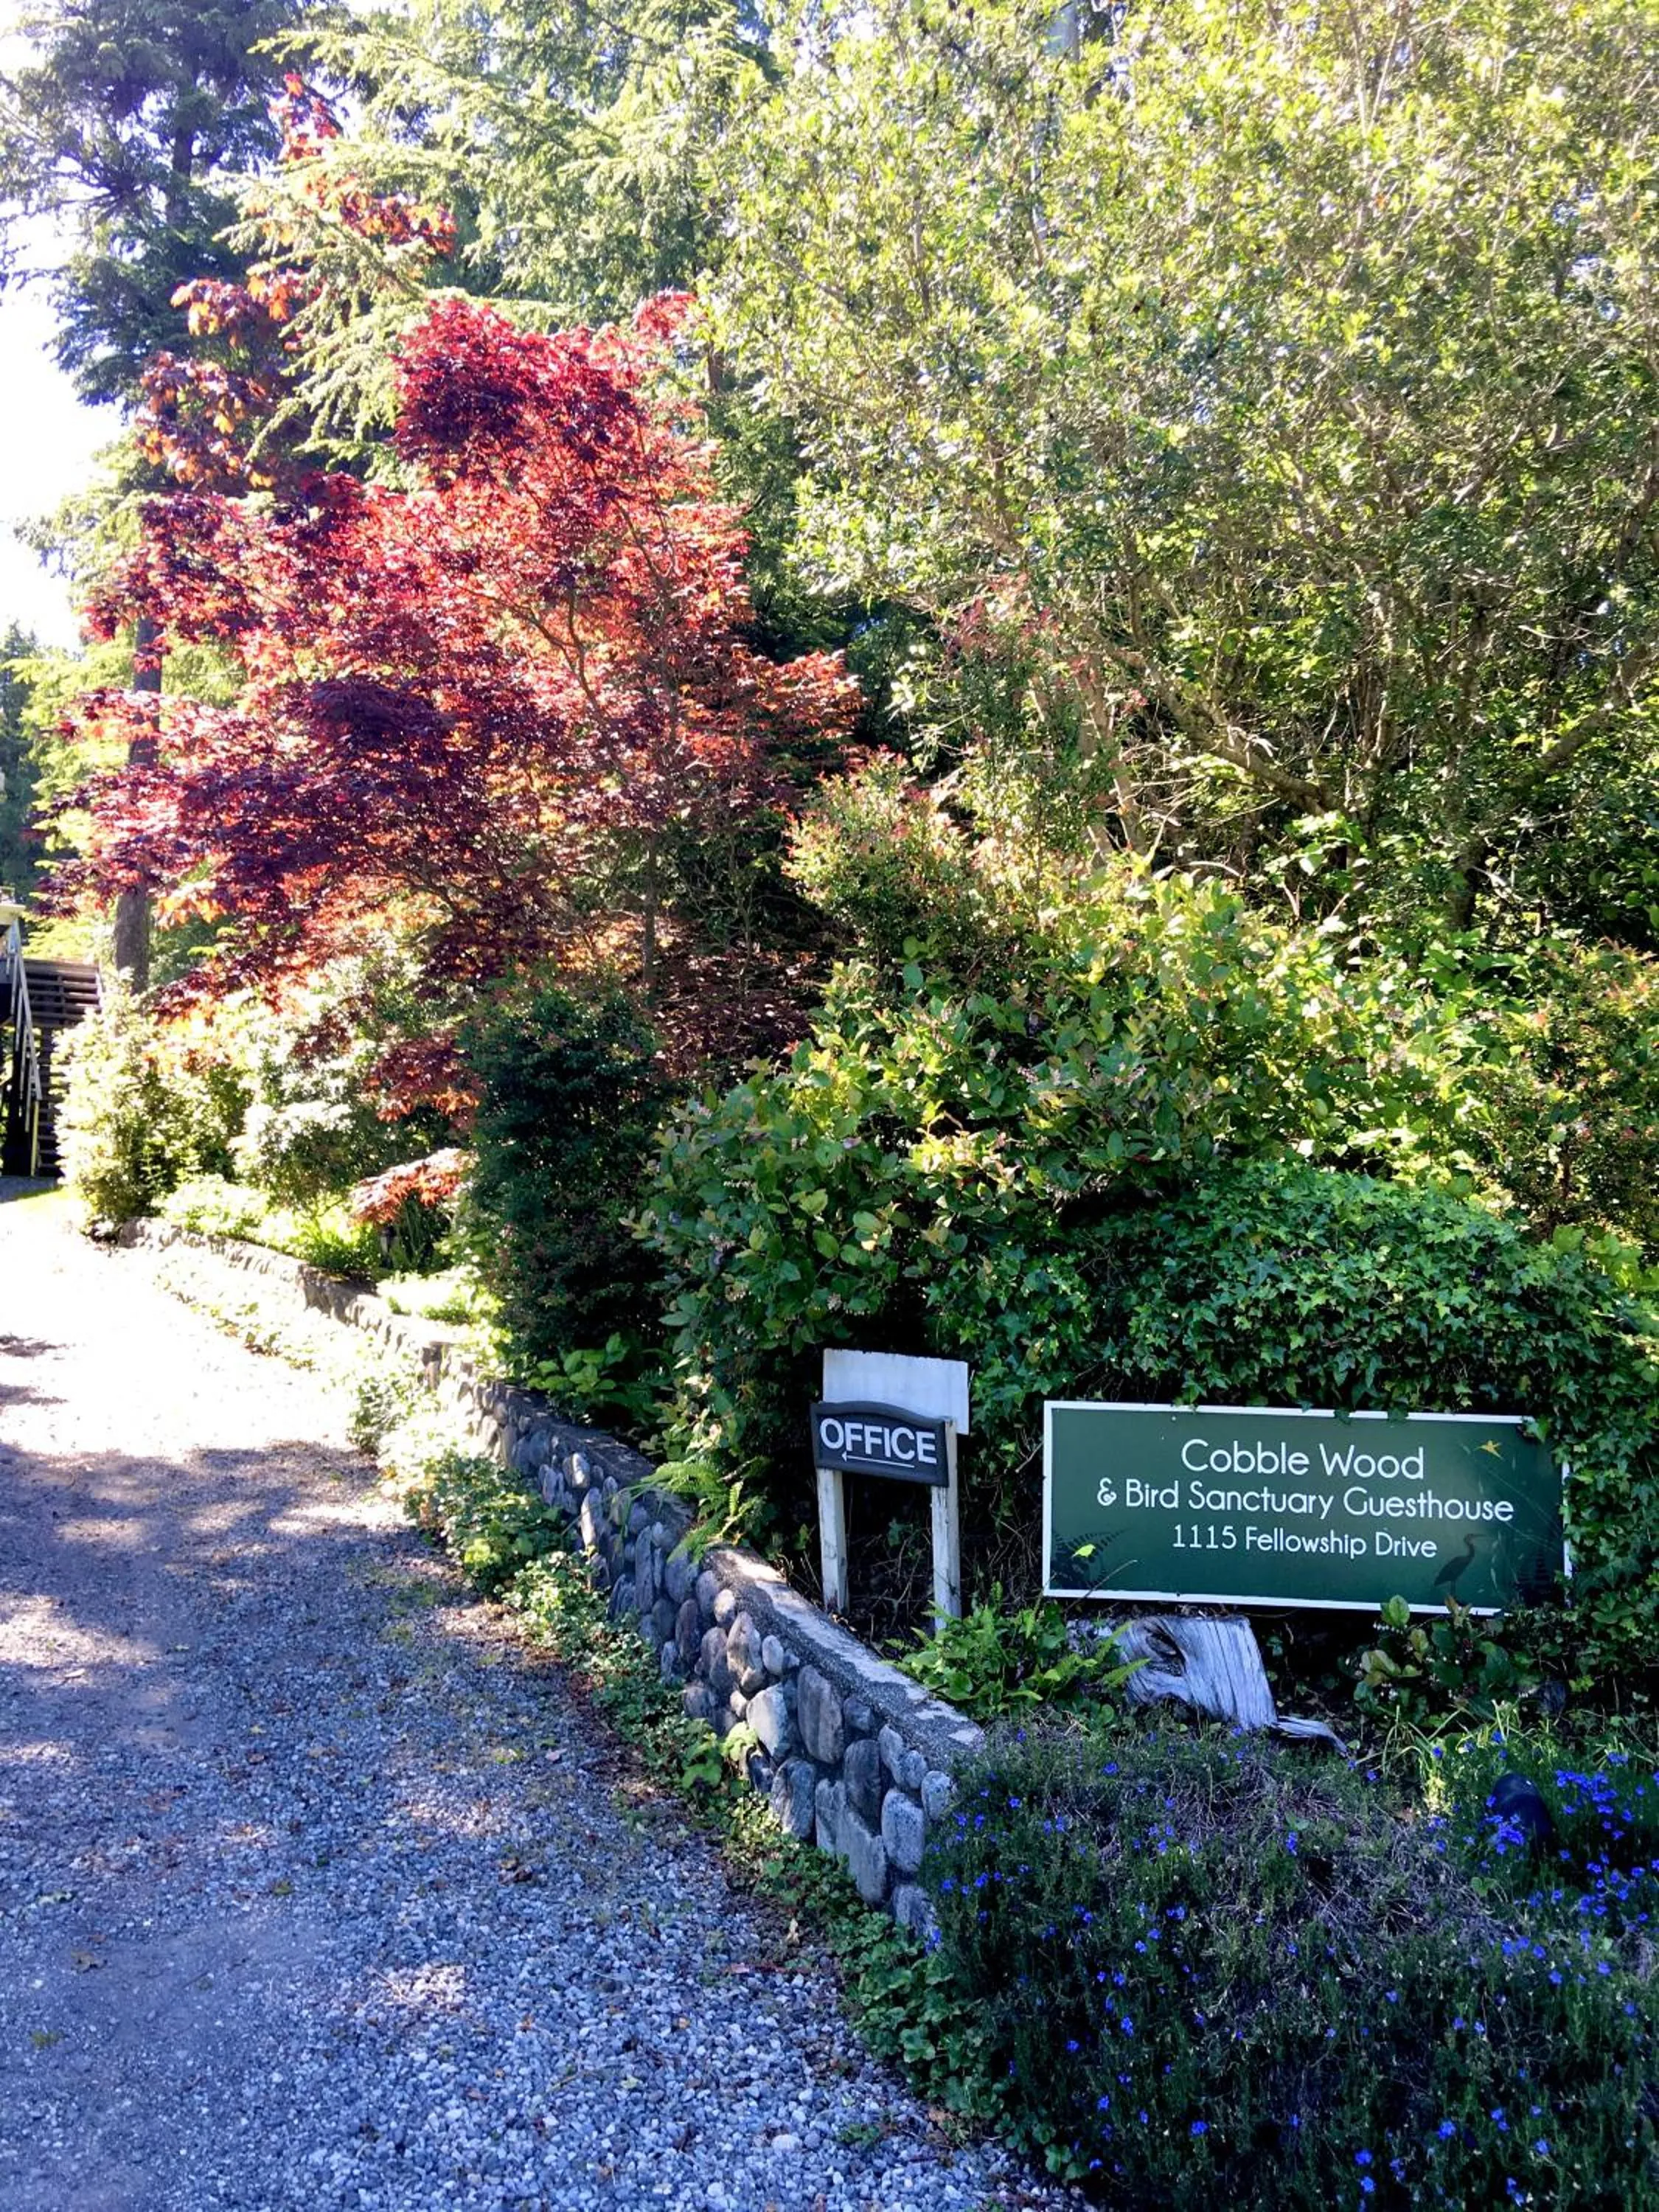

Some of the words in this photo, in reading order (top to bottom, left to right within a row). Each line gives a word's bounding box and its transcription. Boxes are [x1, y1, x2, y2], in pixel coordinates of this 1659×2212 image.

[820, 1418, 937, 1464] OFFICE
[1181, 1438, 1310, 1476] Cobble
[1320, 1443, 1425, 1480] Wood
[1096, 1478, 1117, 1506] &
[1126, 1478, 1179, 1509] Bird
[1188, 1481, 1335, 1519] Sanctuary
[1343, 1486, 1514, 1521] Guesthouse
[1172, 1525, 1237, 1549] 1115
[1245, 1526, 1367, 1559] Fellowship
[1376, 1531, 1438, 1558] Drive
